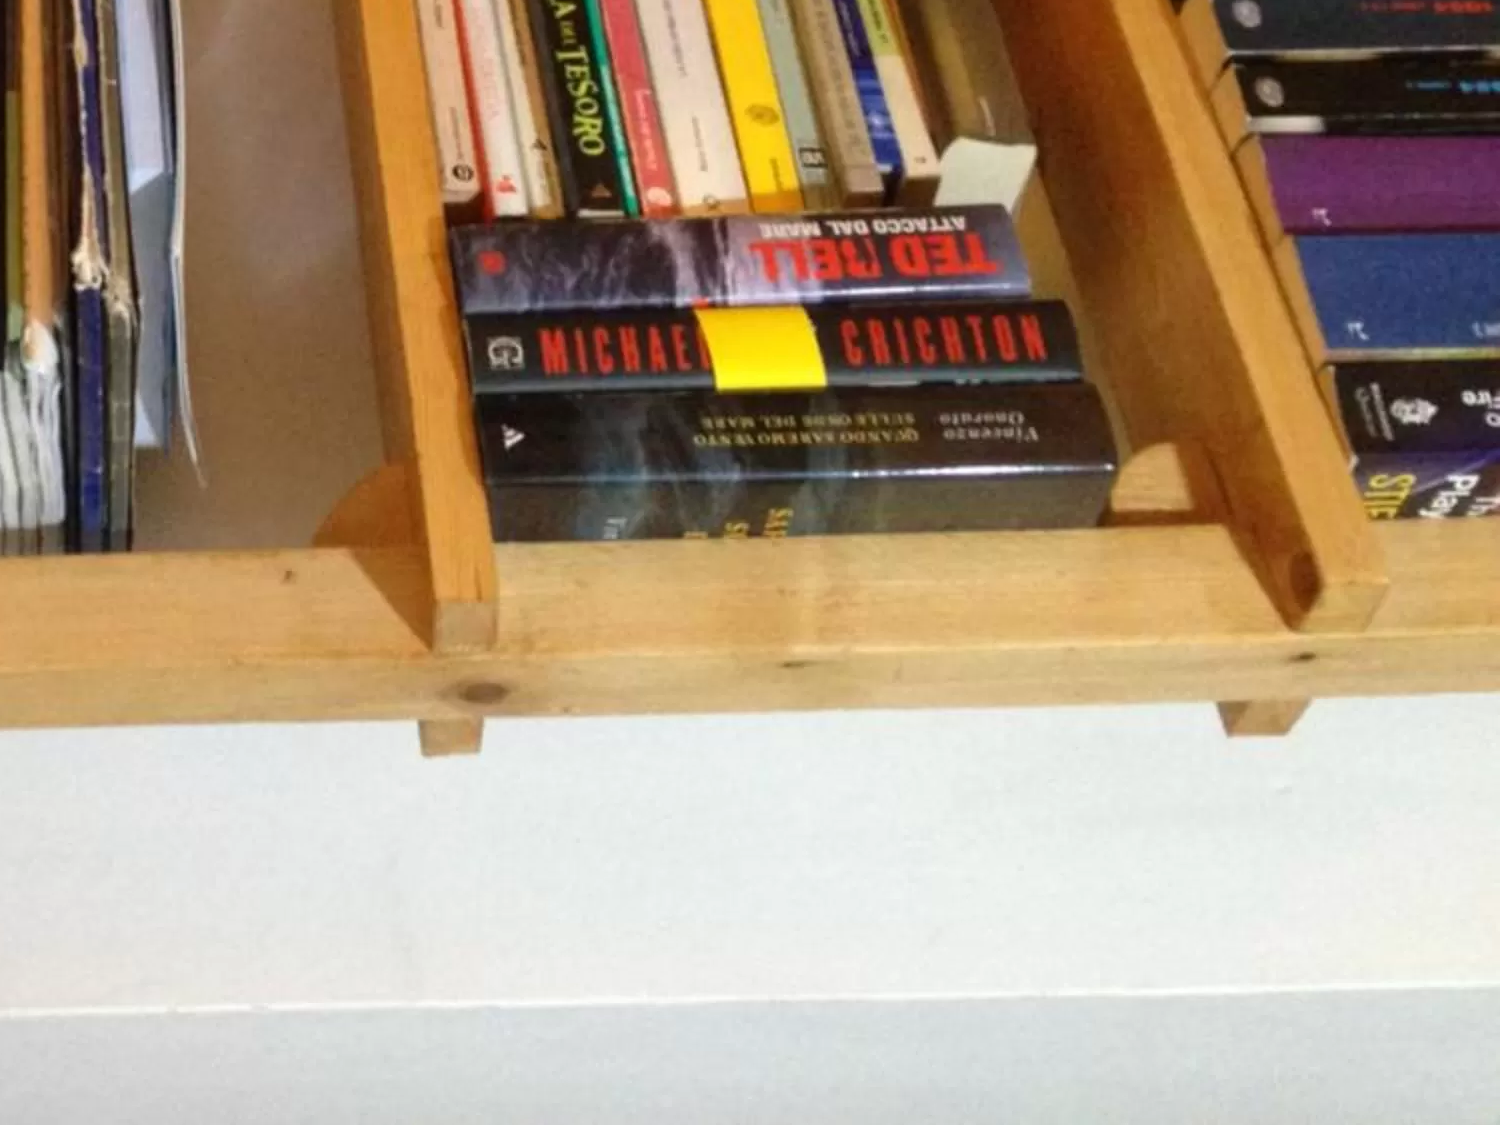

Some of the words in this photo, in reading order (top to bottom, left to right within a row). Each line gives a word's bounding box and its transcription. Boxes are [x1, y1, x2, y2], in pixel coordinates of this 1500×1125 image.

[554, 45, 606, 157] TESORO
[758, 220, 823, 240] MARE
[826, 219, 861, 237] DAL
[869, 215, 968, 236] ATTACCO
[890, 230, 998, 280] TED
[841, 314, 1048, 366] CRICHTON
[940, 411, 1026, 426] Onorato
[840, 428, 921, 446] QUANDO
[942, 425, 1040, 445] Vincenzo
